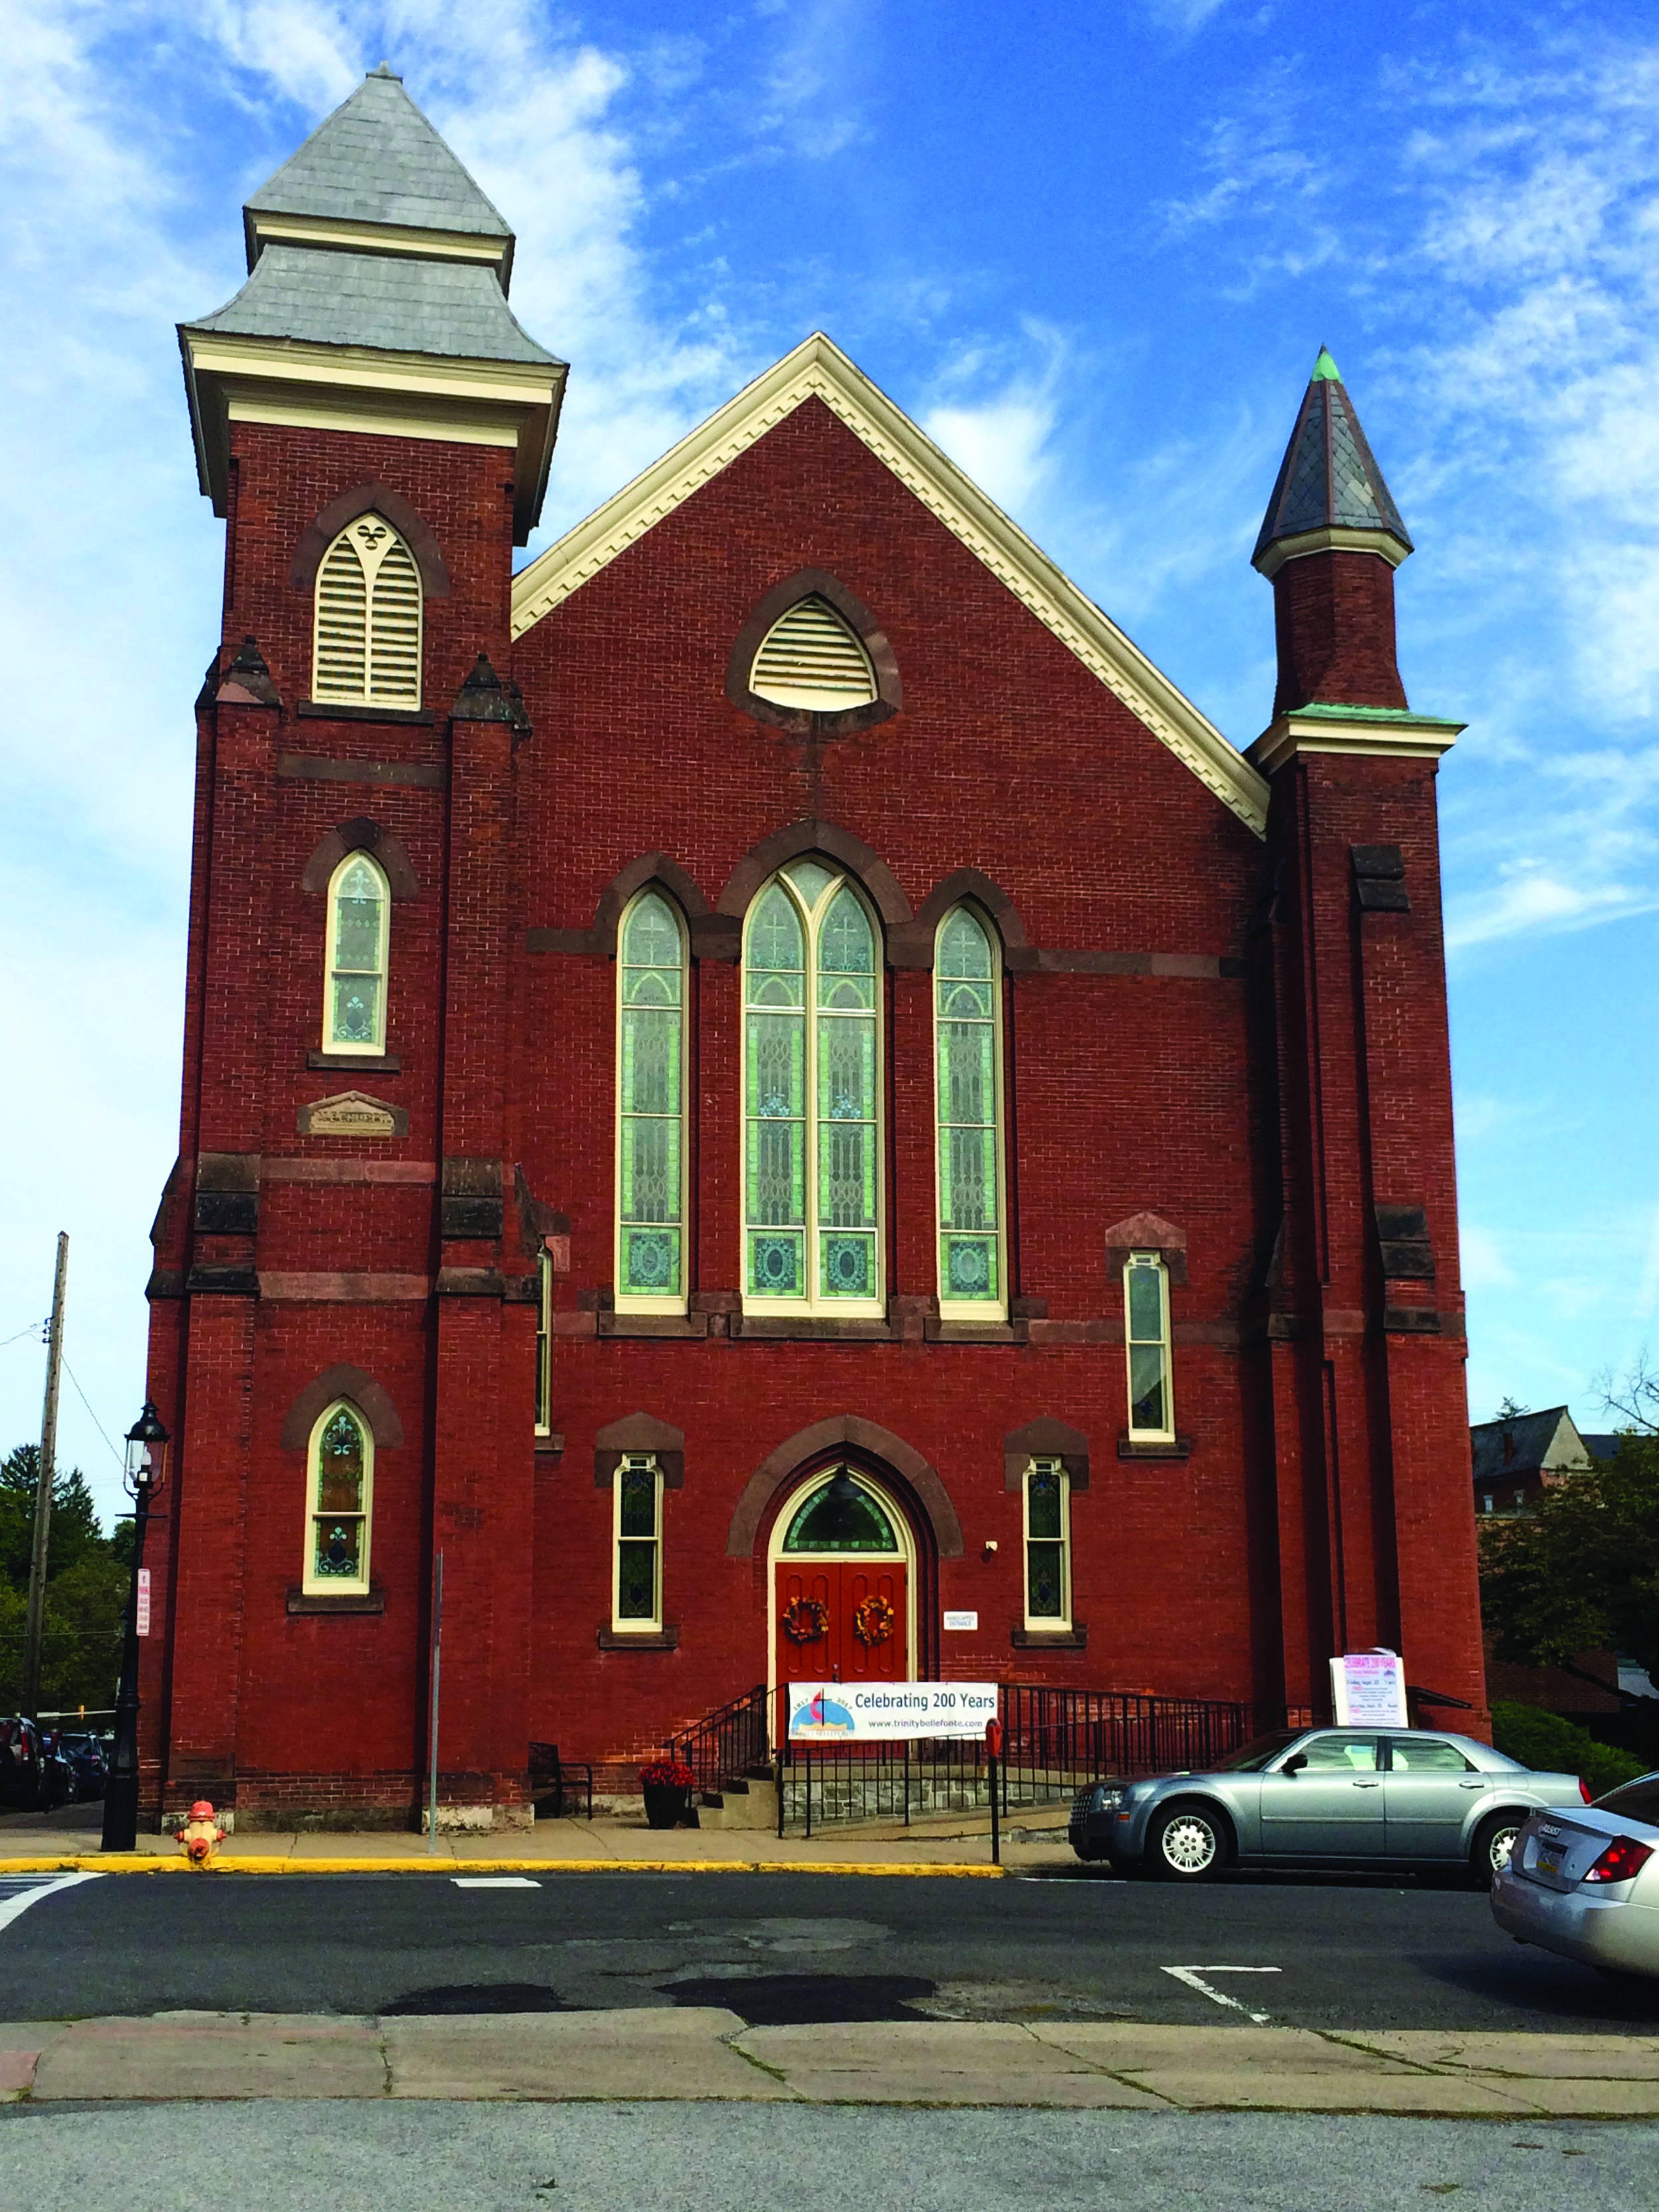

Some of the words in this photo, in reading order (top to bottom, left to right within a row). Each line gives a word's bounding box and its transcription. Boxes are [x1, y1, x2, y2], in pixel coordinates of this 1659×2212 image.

[793, 1697, 809, 1711] 1817
[836, 1697, 853, 1710] 2017
[855, 1692, 928, 1711] Celebrating
[933, 1693, 956, 1708] 200
[959, 1693, 995, 1708] Years
[868, 1719, 982, 1729] www.trinitybellefonte.com
